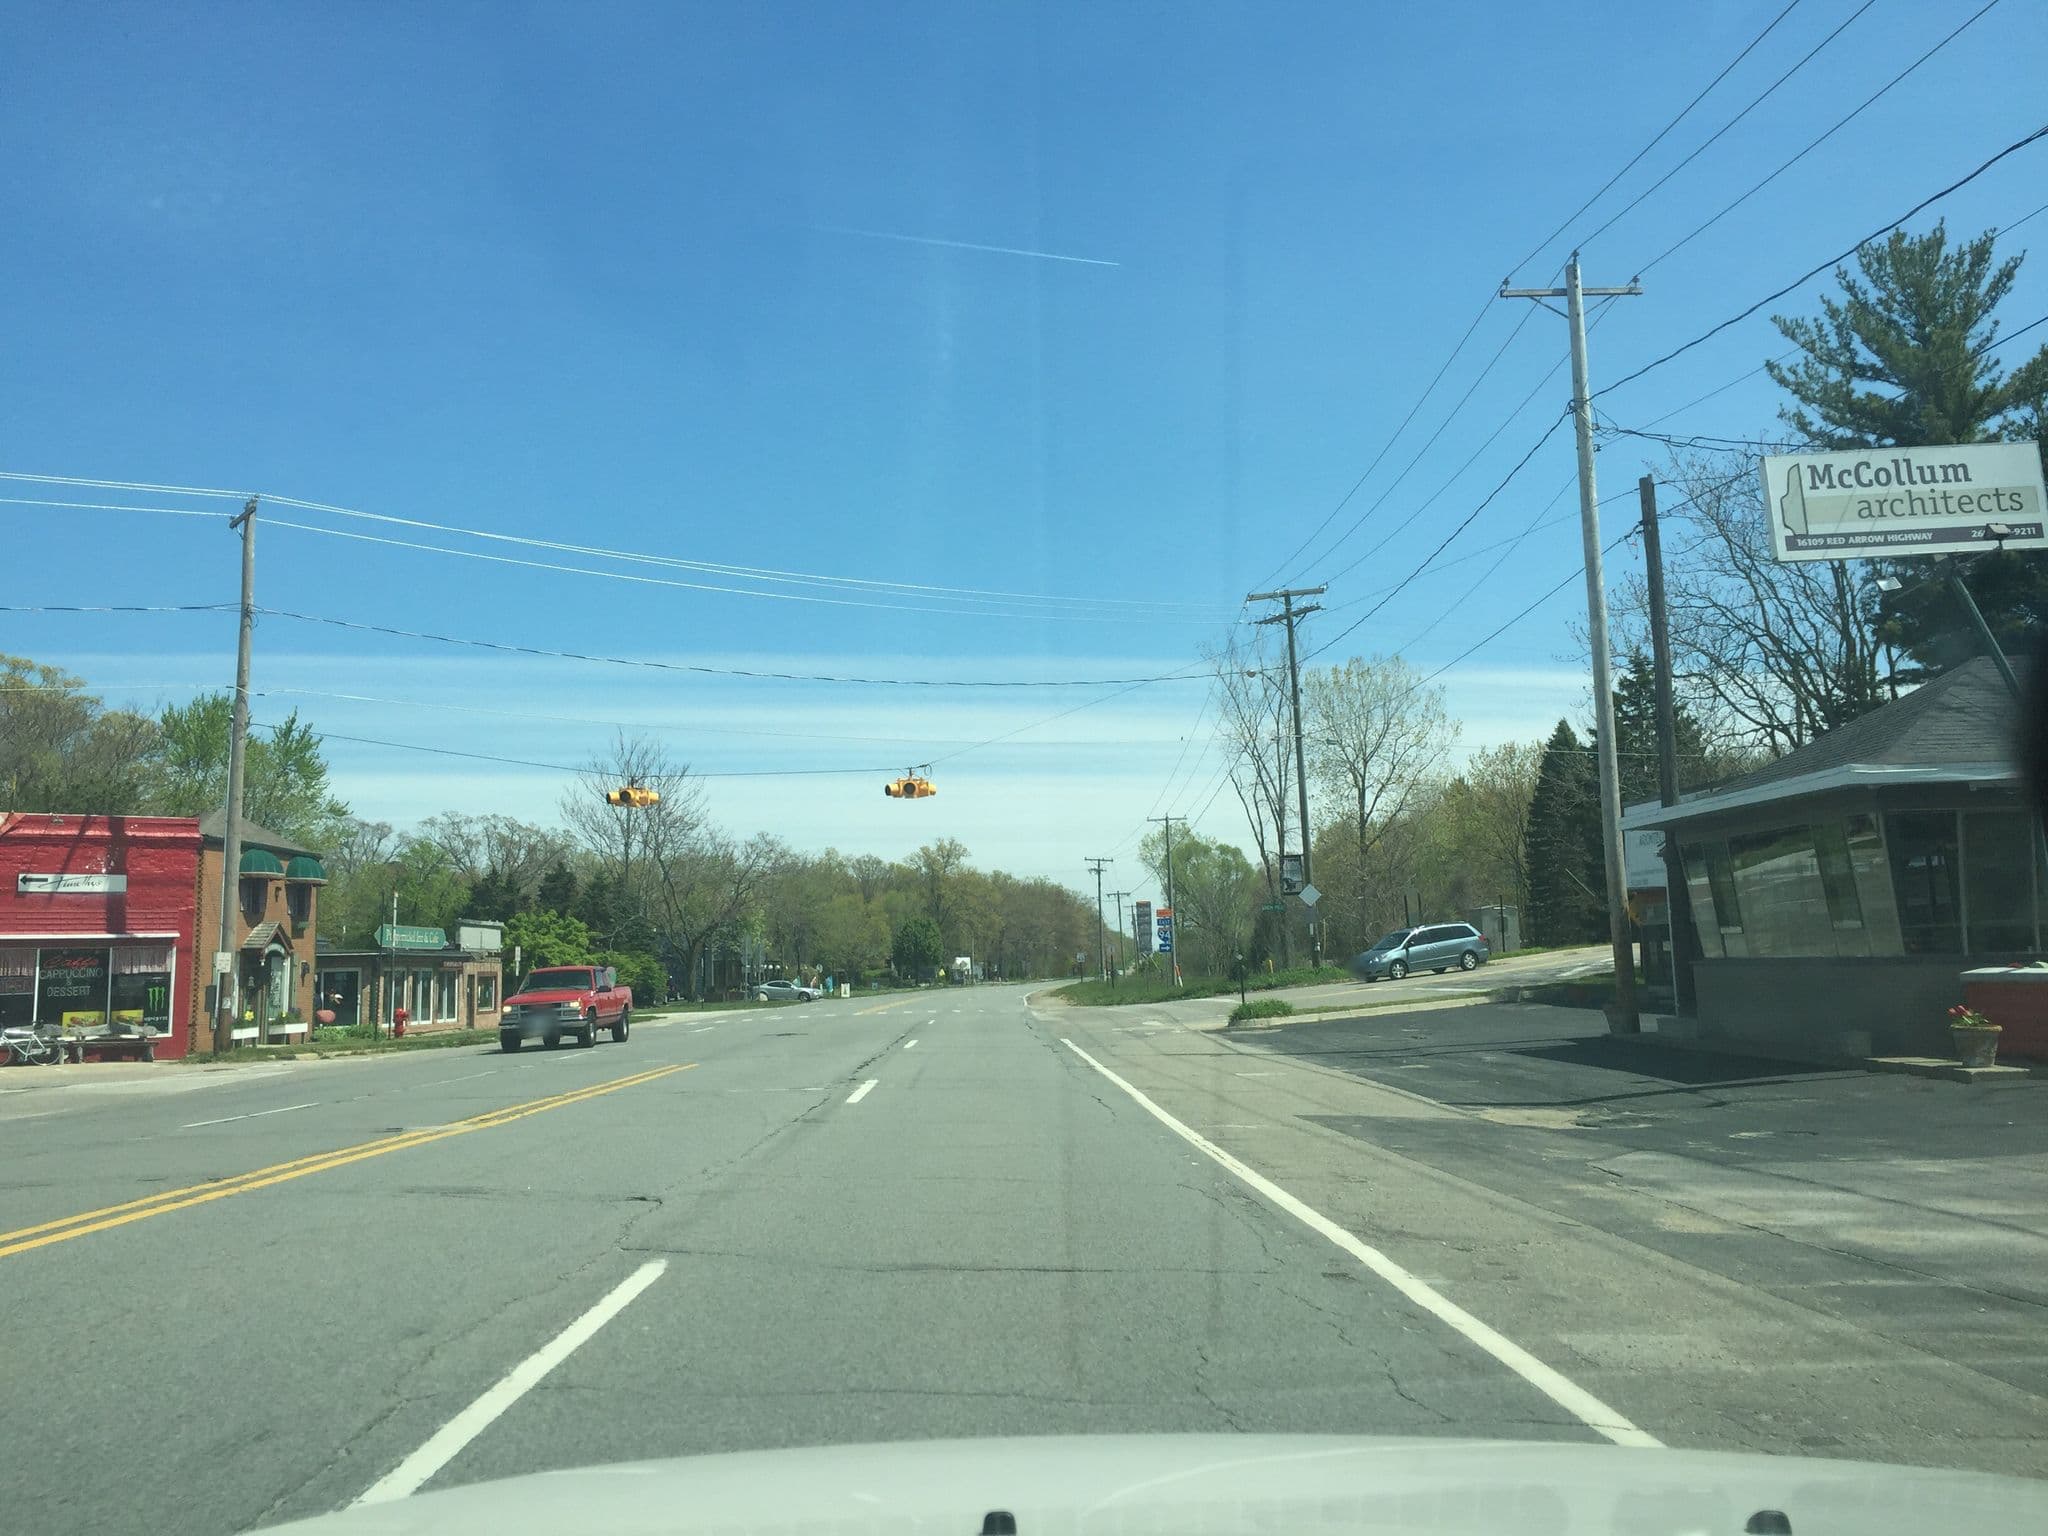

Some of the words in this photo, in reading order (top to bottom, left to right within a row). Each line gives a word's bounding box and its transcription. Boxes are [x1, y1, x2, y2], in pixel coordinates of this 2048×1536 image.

[1807, 457, 1972, 490] McCollum
[1857, 487, 2024, 520] architects
[1796, 538, 1824, 547] 16109
[1826, 537, 1846, 545] RED
[1848, 534, 1885, 544] ARROW
[1887, 532, 1934, 542] HIGHWAY
[1159, 930, 1170, 940] 94
[39, 966, 103, 979] CAPPUCCINO
[46, 985, 91, 997] DESSERT
